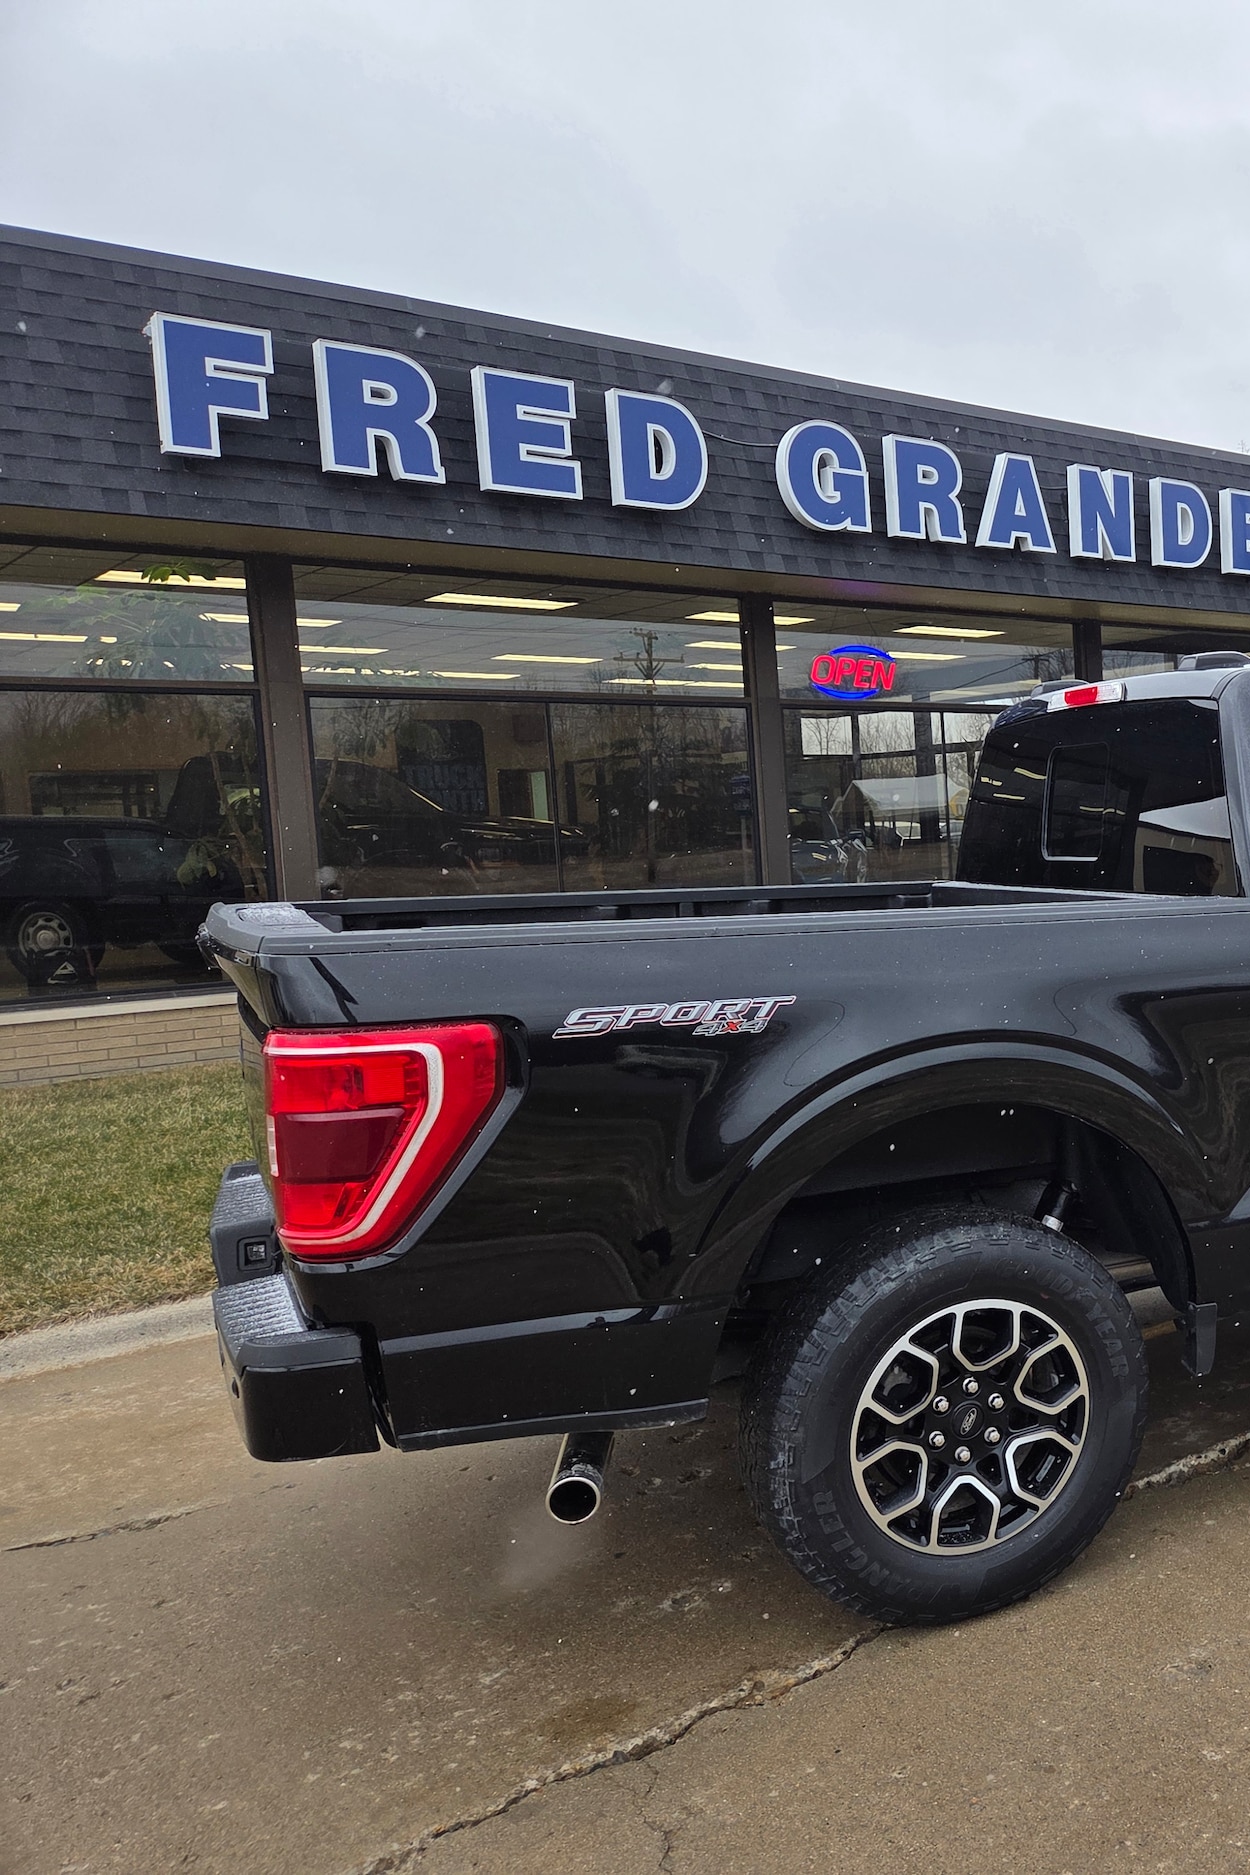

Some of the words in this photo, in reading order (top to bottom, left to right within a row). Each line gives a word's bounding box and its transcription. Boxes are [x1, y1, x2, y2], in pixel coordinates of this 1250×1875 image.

[149, 311, 709, 511] FRED
[810, 654, 897, 691] OPEN
[552, 996, 796, 1039] SPORT
[692, 1018, 768, 1036] 4x4
